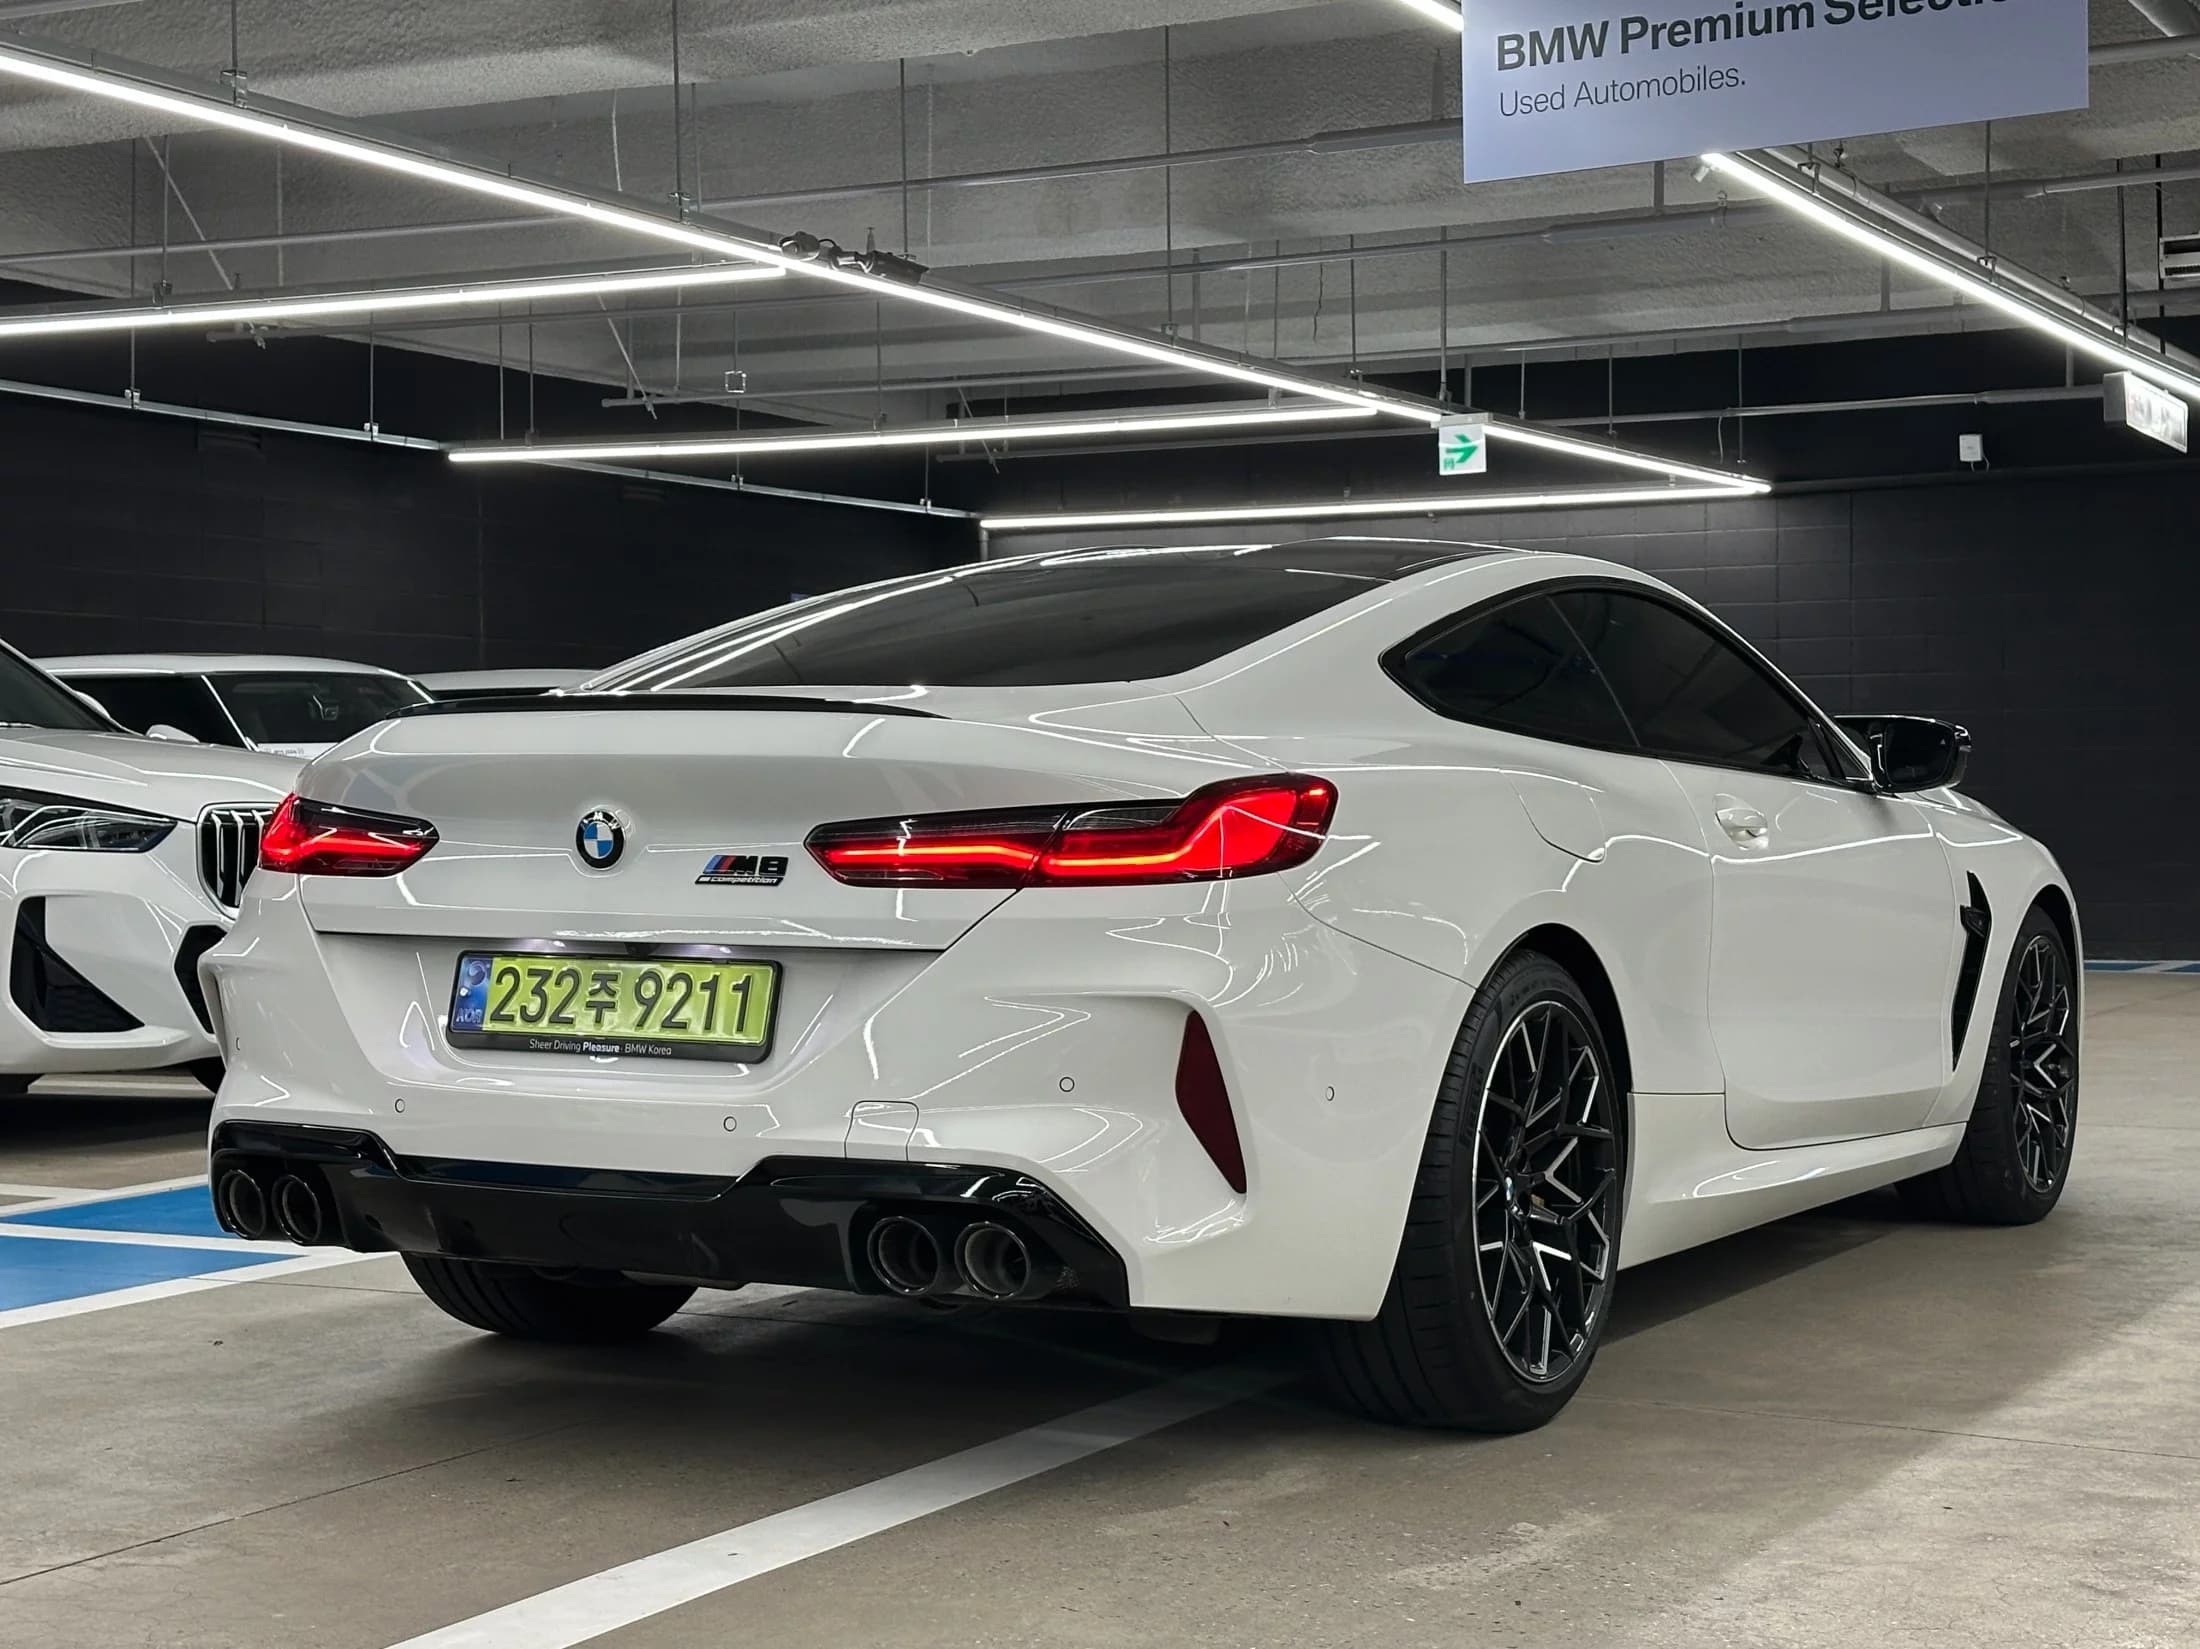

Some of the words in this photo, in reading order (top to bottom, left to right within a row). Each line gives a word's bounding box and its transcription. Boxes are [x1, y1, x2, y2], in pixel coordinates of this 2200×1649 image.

[1498, 20, 1609, 71] BMW
[1620, 1, 1814, 54] Premium
[1500, 84, 1565, 117] Used
[1574, 65, 1746, 107] Automobiles.
[490, 966, 621, 1026] 232주
[634, 970, 752, 1034] 9211
[529, 1038, 552, 1049] Sheer
[553, 1040, 581, 1053] Driving
[582, 1041, 620, 1053] Pleasure
[624, 1043, 647, 1053] BMW
[649, 1044, 672, 1055] Korea
